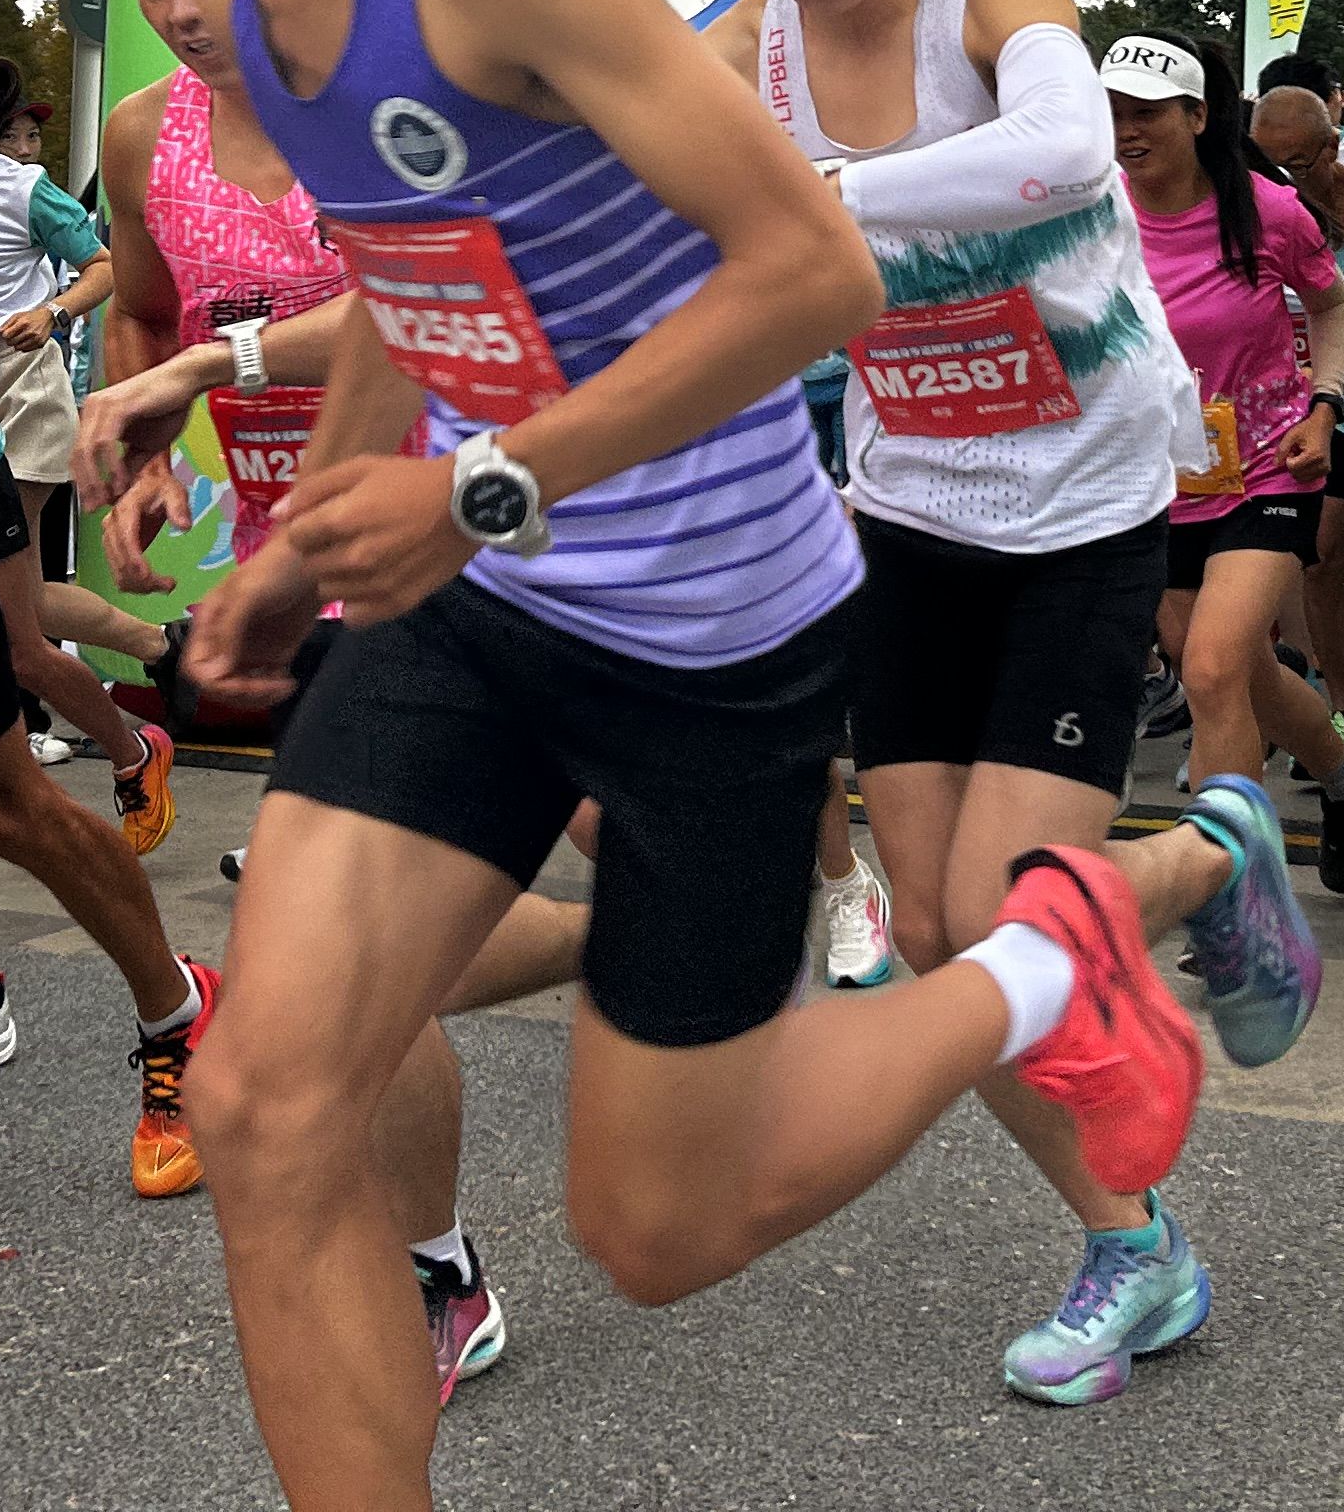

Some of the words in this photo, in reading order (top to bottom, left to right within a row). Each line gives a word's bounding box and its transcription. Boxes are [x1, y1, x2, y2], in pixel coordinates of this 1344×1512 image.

[767, 29, 795, 138] LIPBELT
[1107, 46, 1179, 76] ORT
[862, 348, 1030, 399] M2587
